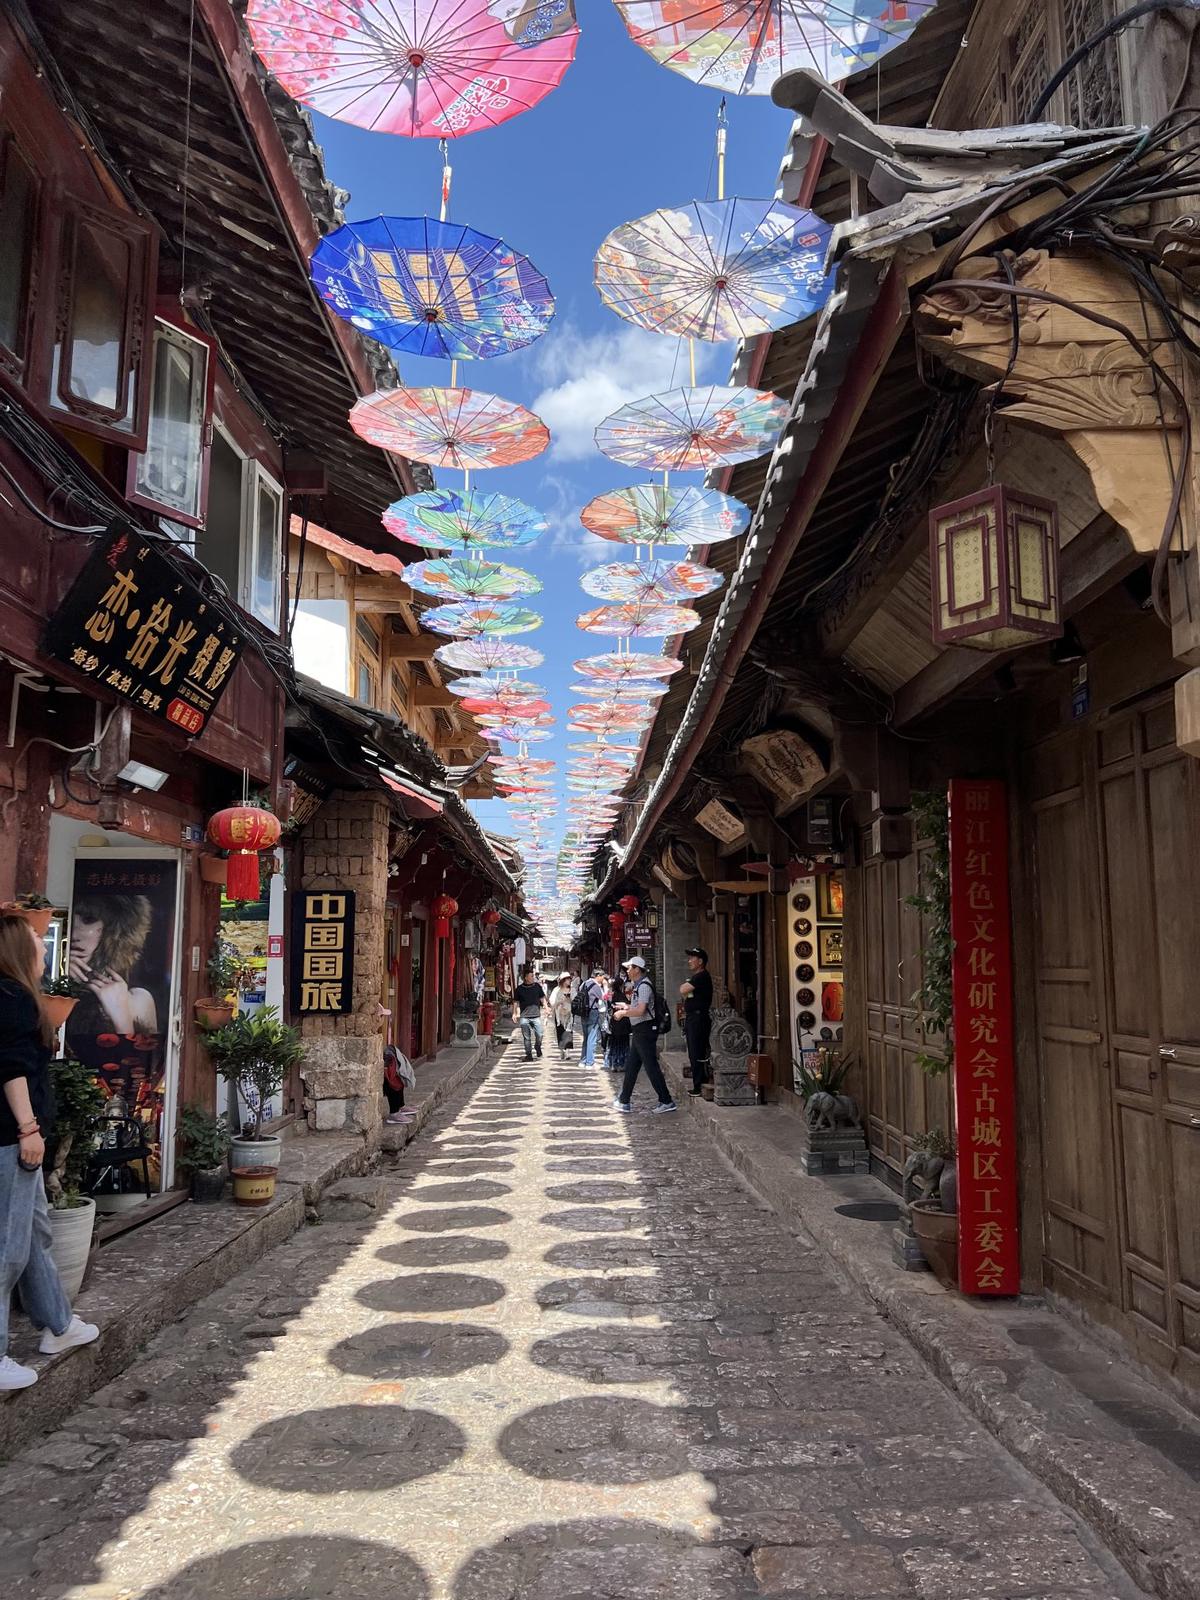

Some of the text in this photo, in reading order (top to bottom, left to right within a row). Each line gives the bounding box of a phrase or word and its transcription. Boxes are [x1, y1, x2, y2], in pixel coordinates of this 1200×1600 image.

[172, 702, 203, 731] 精品店
[300, 893, 346, 1010] 中国国旅
[964, 785, 1004, 1289] 丽江红色文化研究会古城区工委会
